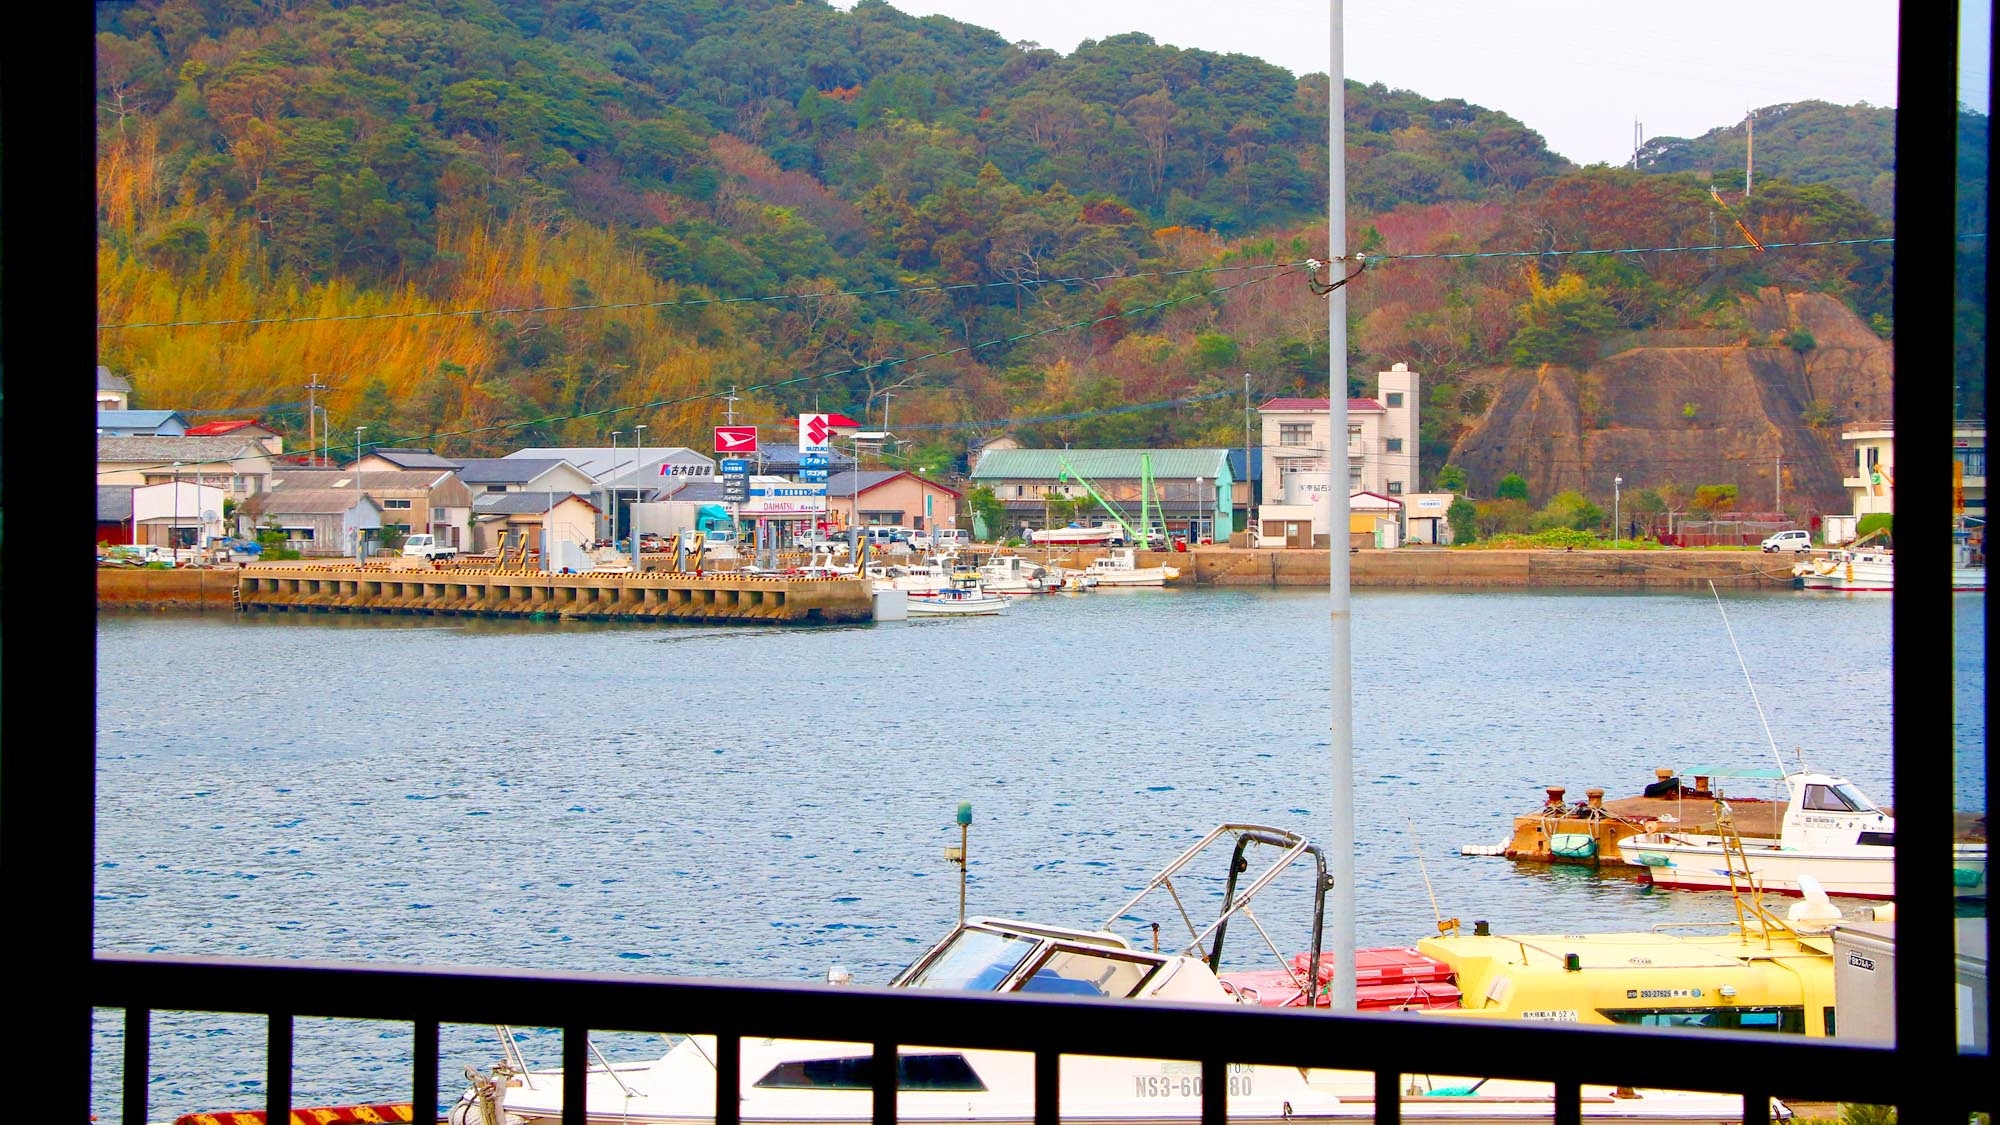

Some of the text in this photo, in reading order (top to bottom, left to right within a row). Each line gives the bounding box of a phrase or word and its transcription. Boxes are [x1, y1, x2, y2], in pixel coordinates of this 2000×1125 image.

[806, 457, 828, 465] アルト
[671, 465, 712, 476] 古木自動車
[763, 502, 795, 510] DAIHATSU
